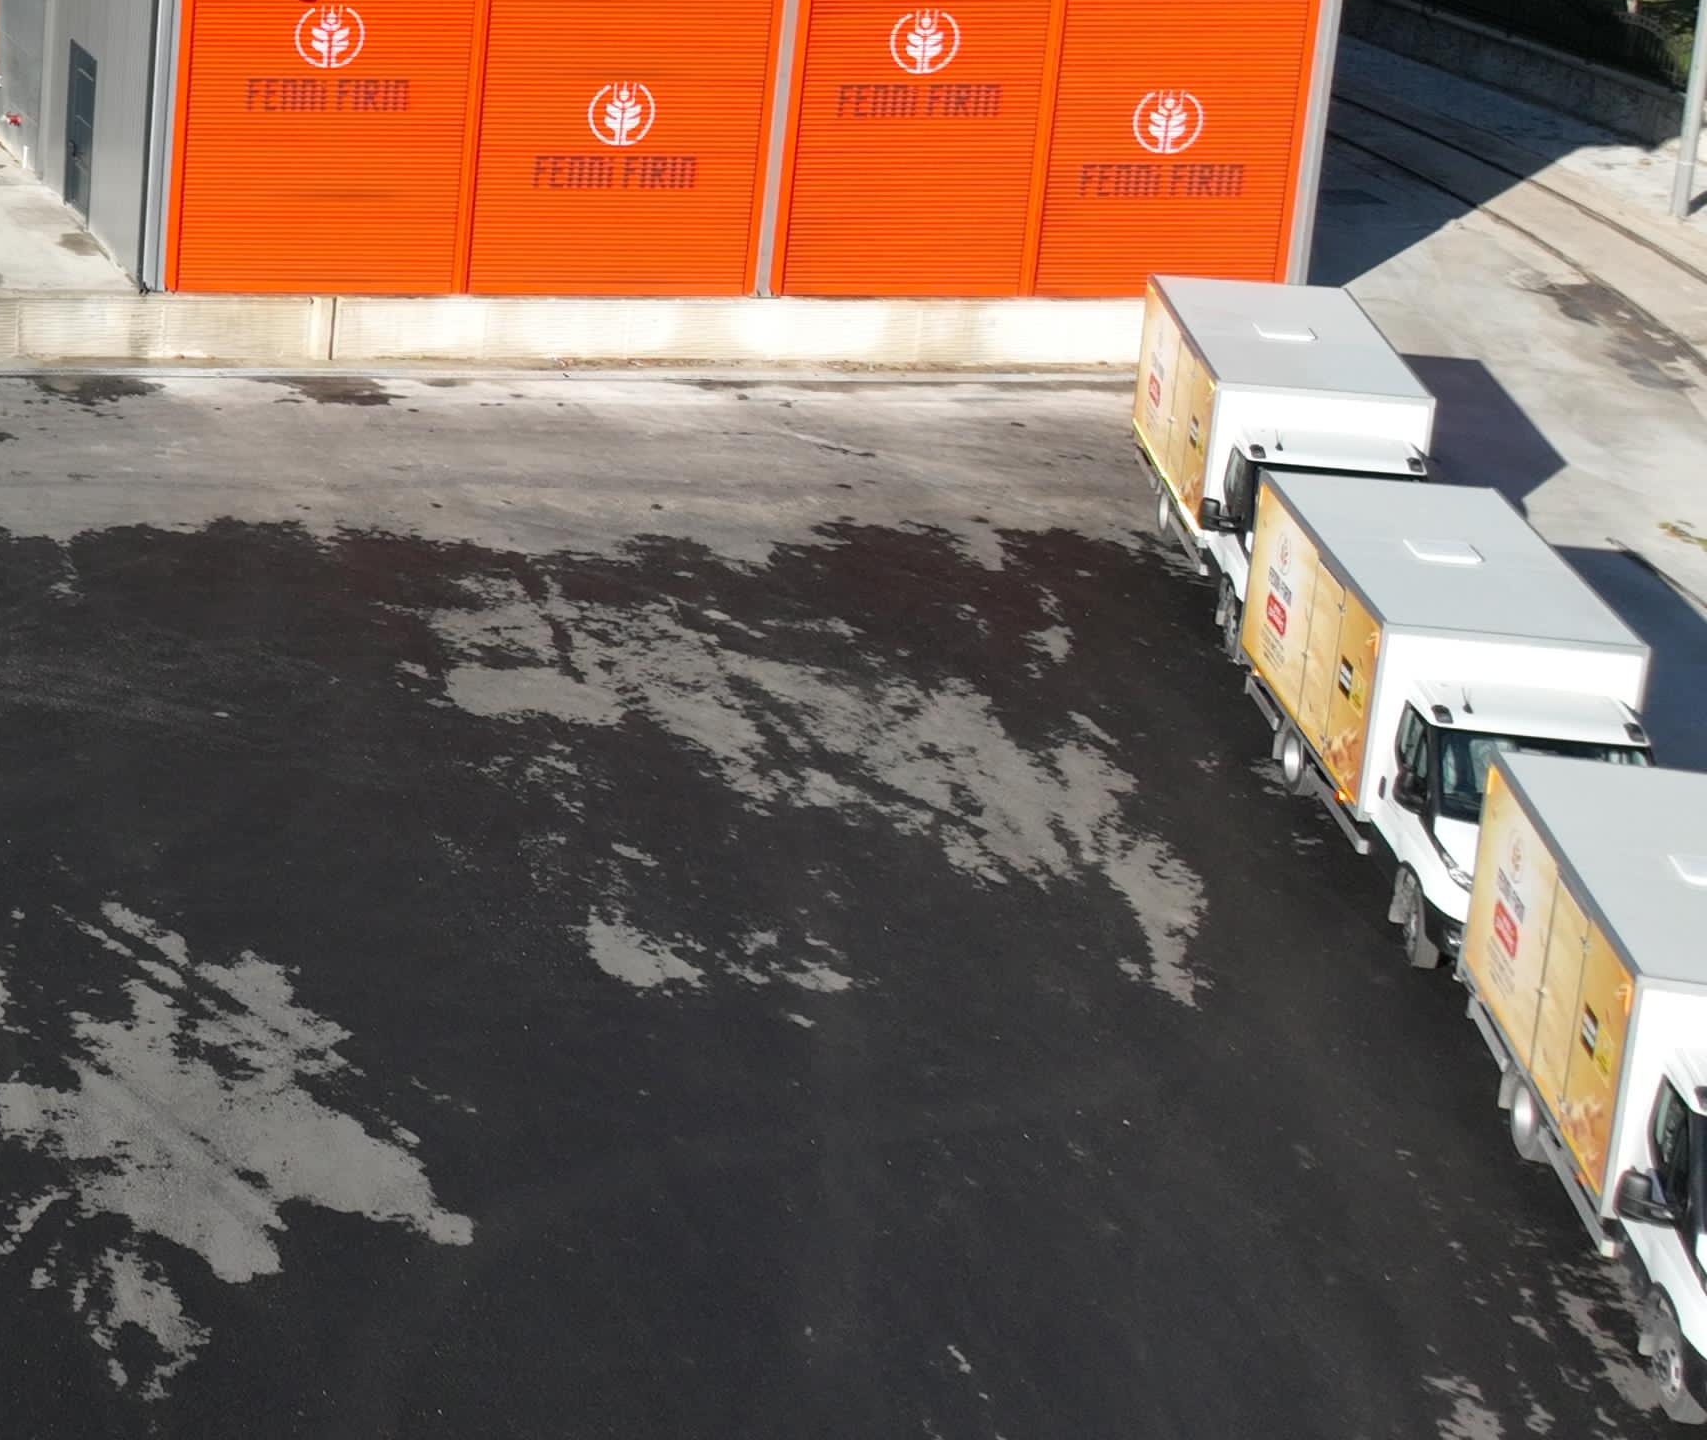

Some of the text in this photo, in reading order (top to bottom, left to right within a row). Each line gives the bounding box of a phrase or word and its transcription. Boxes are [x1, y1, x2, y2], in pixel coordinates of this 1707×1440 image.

[336, 78, 410, 112] FIRIN
[926, 84, 1002, 117] FIRIN
[622, 156, 697, 189] FIRIN
[1170, 164, 1244, 197] FIRIN
